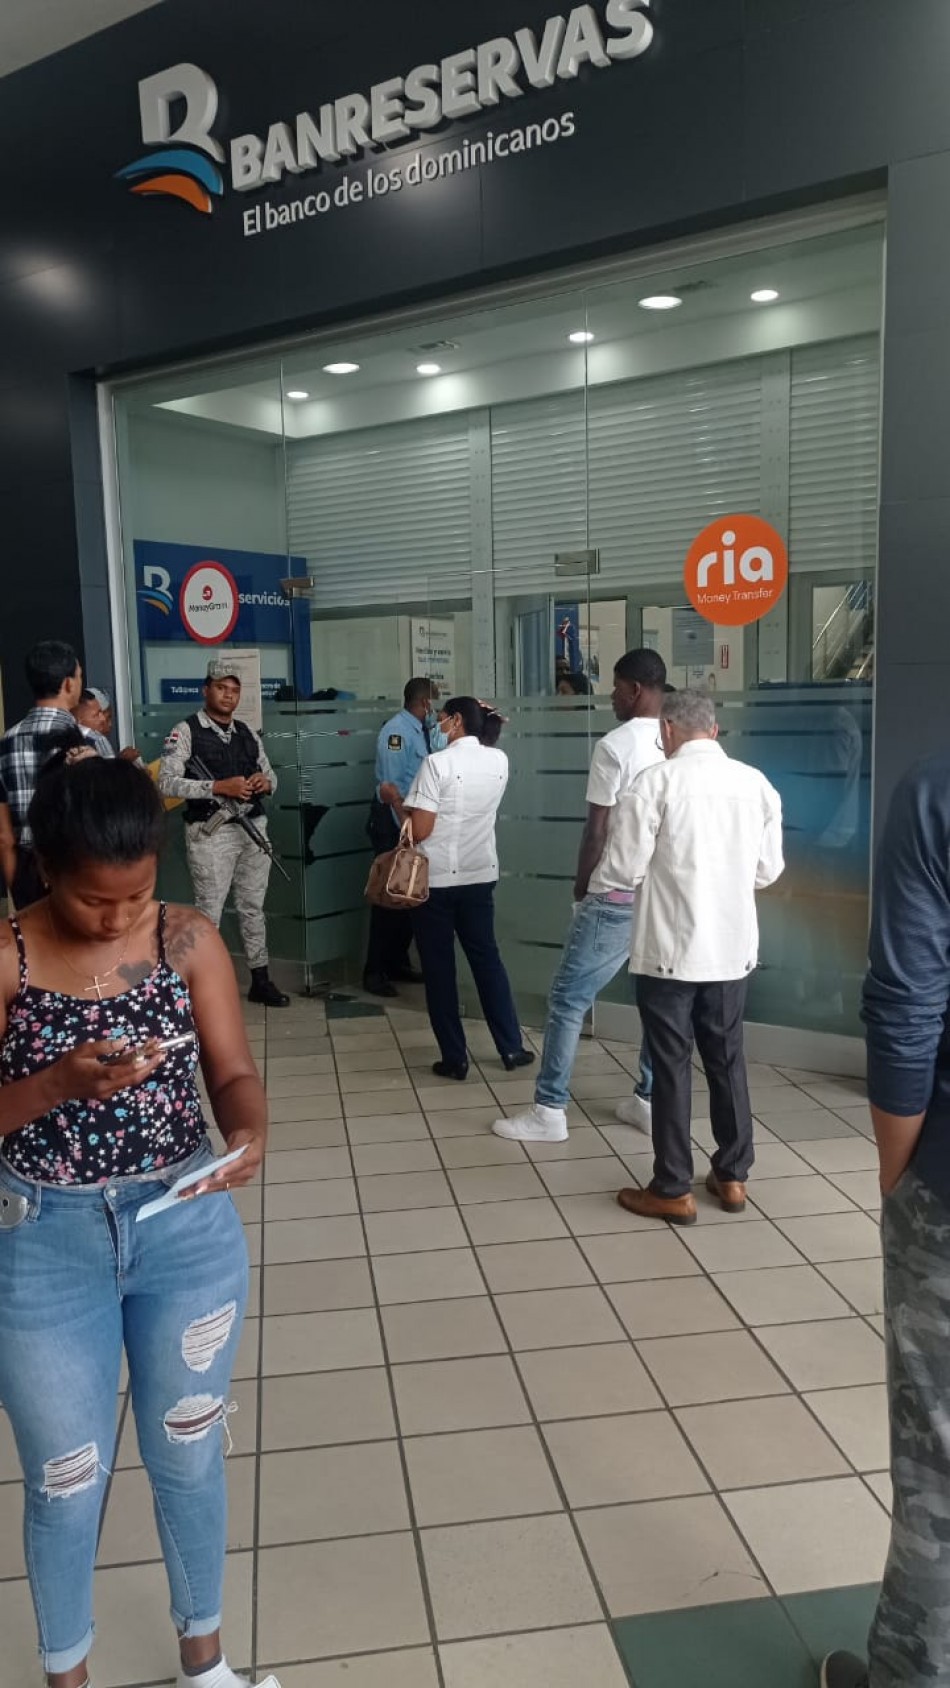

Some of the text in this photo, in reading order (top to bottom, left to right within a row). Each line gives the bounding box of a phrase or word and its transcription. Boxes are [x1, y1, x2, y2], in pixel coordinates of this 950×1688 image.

[231, 0, 653, 191] BANRESERVAS
[243, 112, 575, 236] El banco de los dominicanos
[697, 530, 773, 588] ria
[697, 587, 773, 605] Money Transfer
